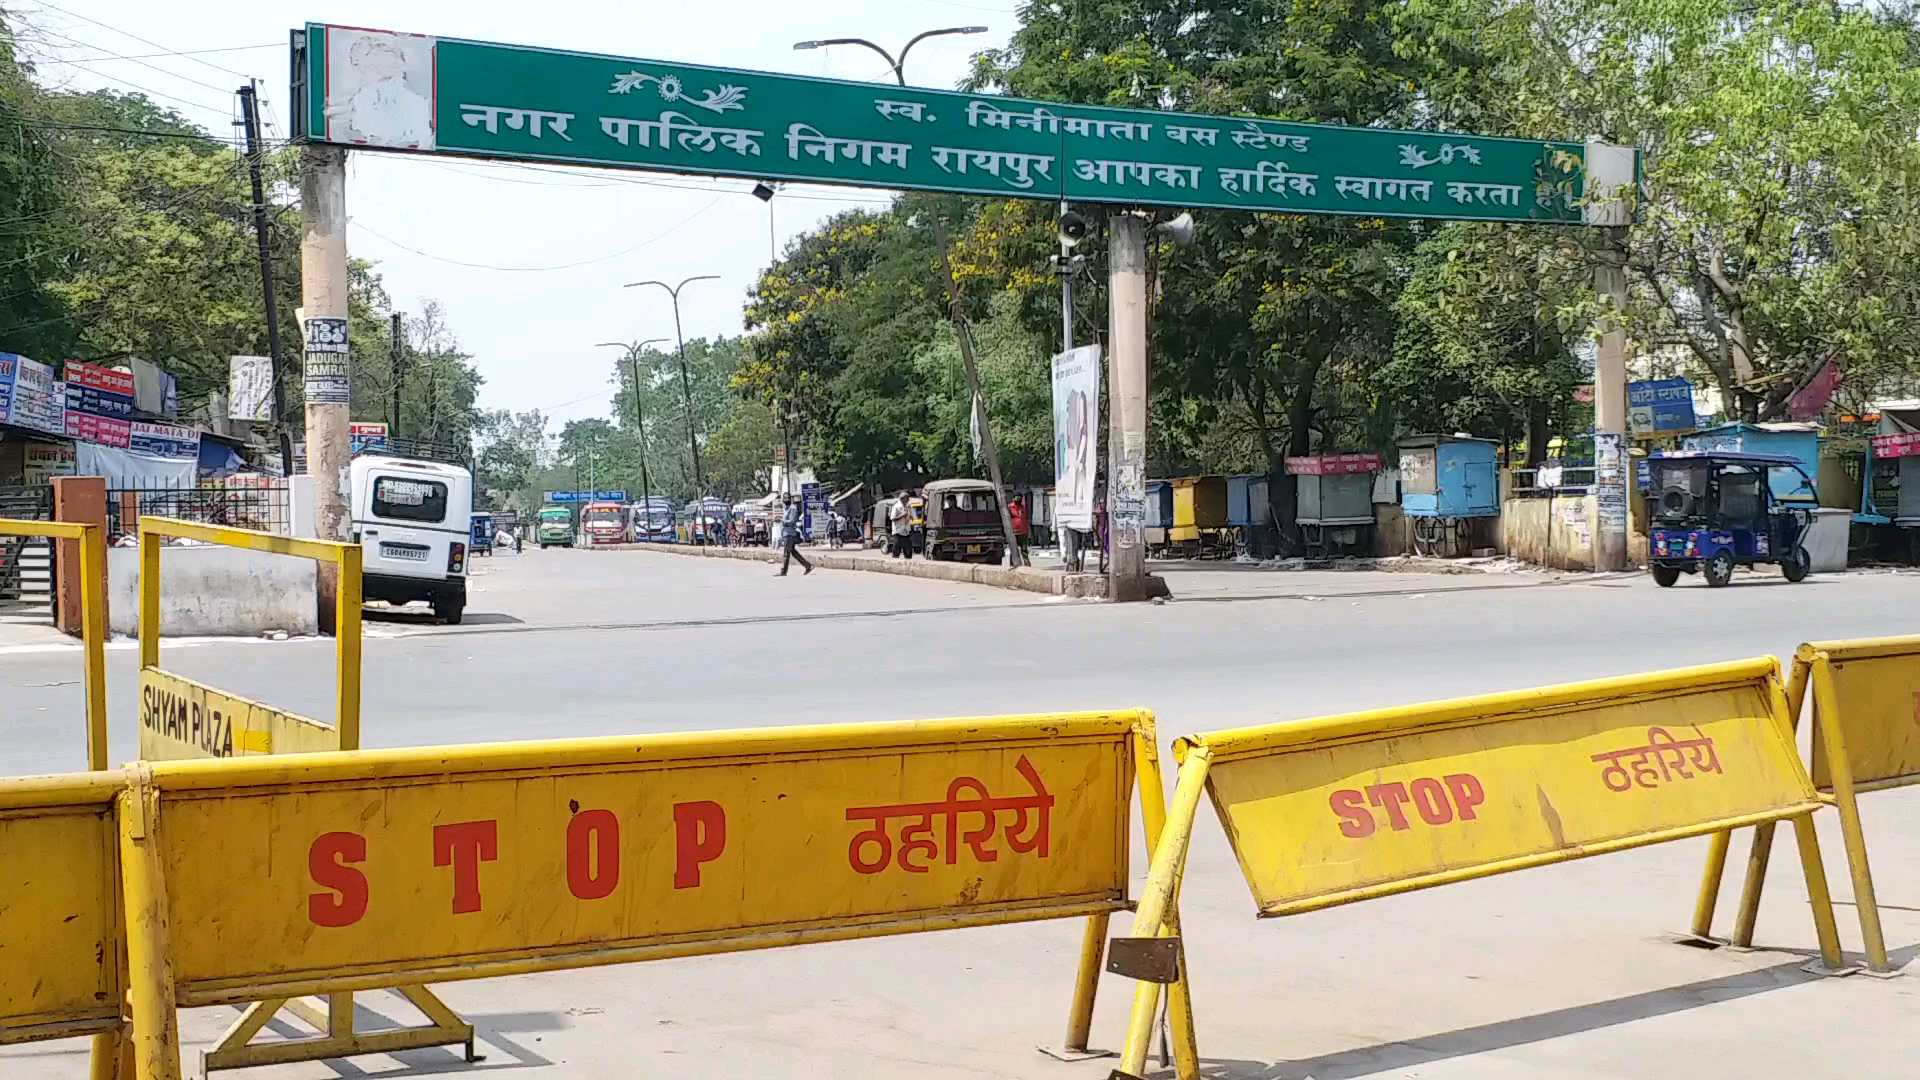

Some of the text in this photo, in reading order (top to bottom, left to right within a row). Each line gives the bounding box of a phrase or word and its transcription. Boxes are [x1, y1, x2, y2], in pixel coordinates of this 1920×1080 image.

[460, 103, 1523, 206] नगर पालिक निगम रायपुर आपका हार्दिक स्वागत करता
[874, 99, 937, 123] स्व.
[965, 100, 1152, 142] मिनीमाता
[143, 684, 233, 757] SHYAM PLAZA
[1590, 723, 1723, 792] ठहरिये
[846, 754, 1055, 874] ठहरिये
[1329, 773, 1485, 838] STOP
[308, 800, 727, 928] STOP
